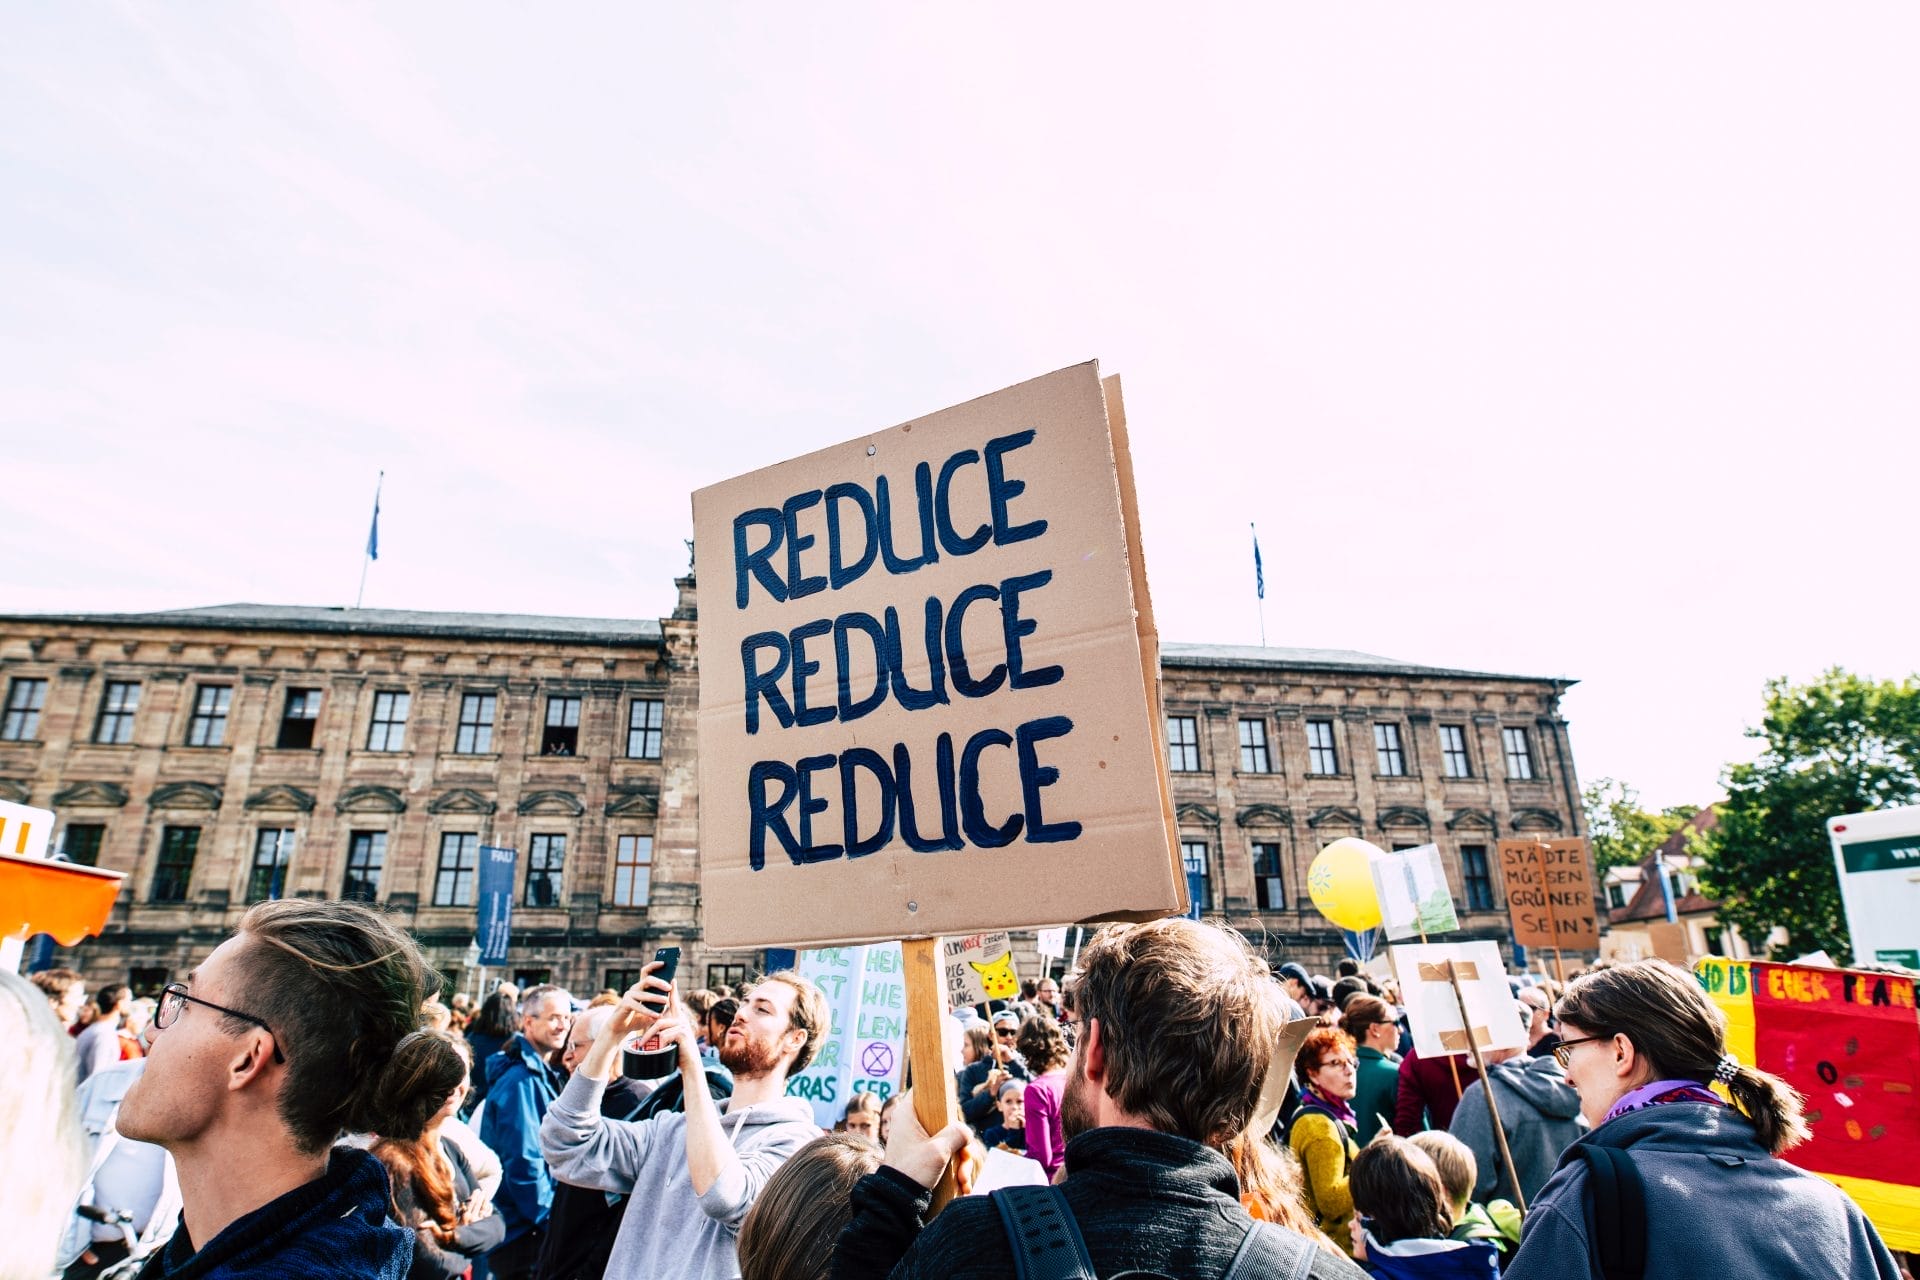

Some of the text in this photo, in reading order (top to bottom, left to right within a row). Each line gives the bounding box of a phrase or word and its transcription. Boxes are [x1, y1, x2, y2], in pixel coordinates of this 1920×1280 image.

[734, 429, 1048, 609] REDUCE
[741, 570, 1064, 735] REDUCE
[749, 716, 1083, 871] REDUCE
[1505, 846, 1580, 865] STÄDTE
[1507, 867, 1583, 885] MÜSSEN
[1511, 887, 1588, 907] GRÜNER
[862, 979, 902, 1009] WIE
[1729, 965, 1761, 996] IST
[1768, 969, 1831, 1003] EUER
[1842, 974, 1914, 1009] PLAN
[857, 1012, 900, 1040] LEN
[783, 1075, 837, 1103] KRAS
